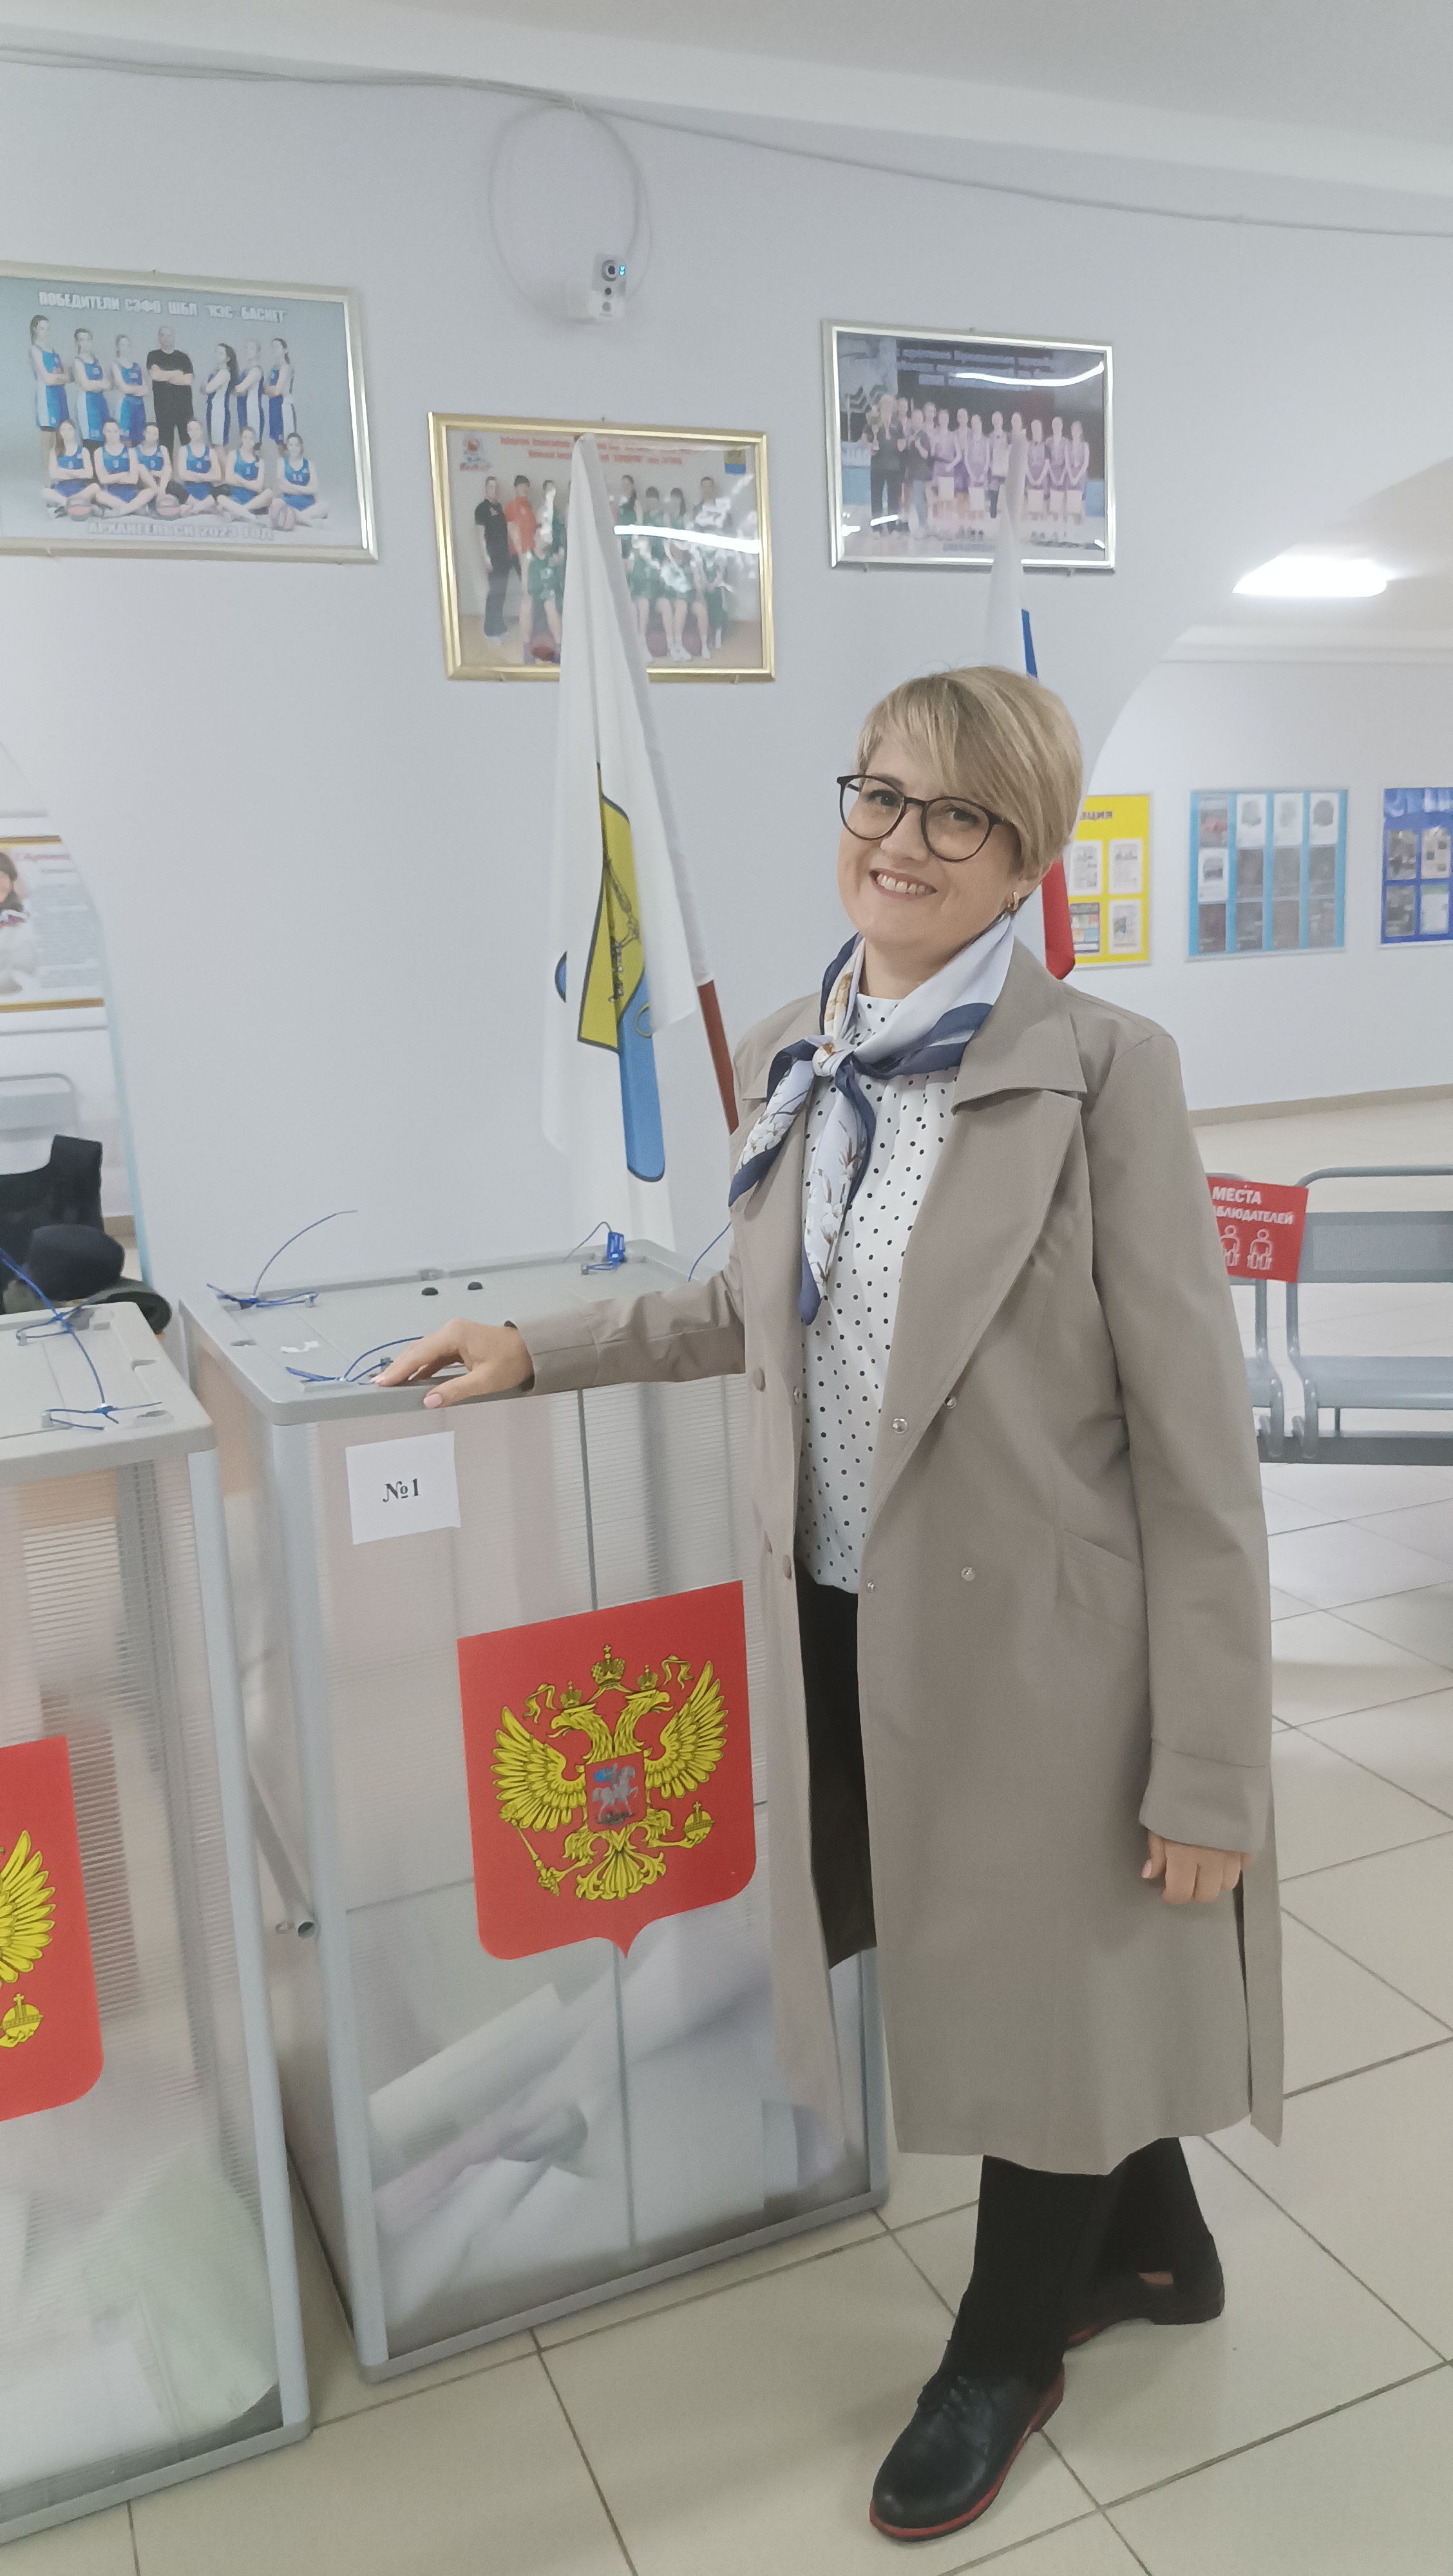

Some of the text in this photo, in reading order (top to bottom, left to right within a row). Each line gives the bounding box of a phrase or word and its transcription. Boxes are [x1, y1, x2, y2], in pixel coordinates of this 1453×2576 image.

[39, 291, 120, 311] ПОБЕДИТЕЛИ
[1211, 1186, 1262, 1205] МЕСТА
[382, 1478, 421, 1502] №1
